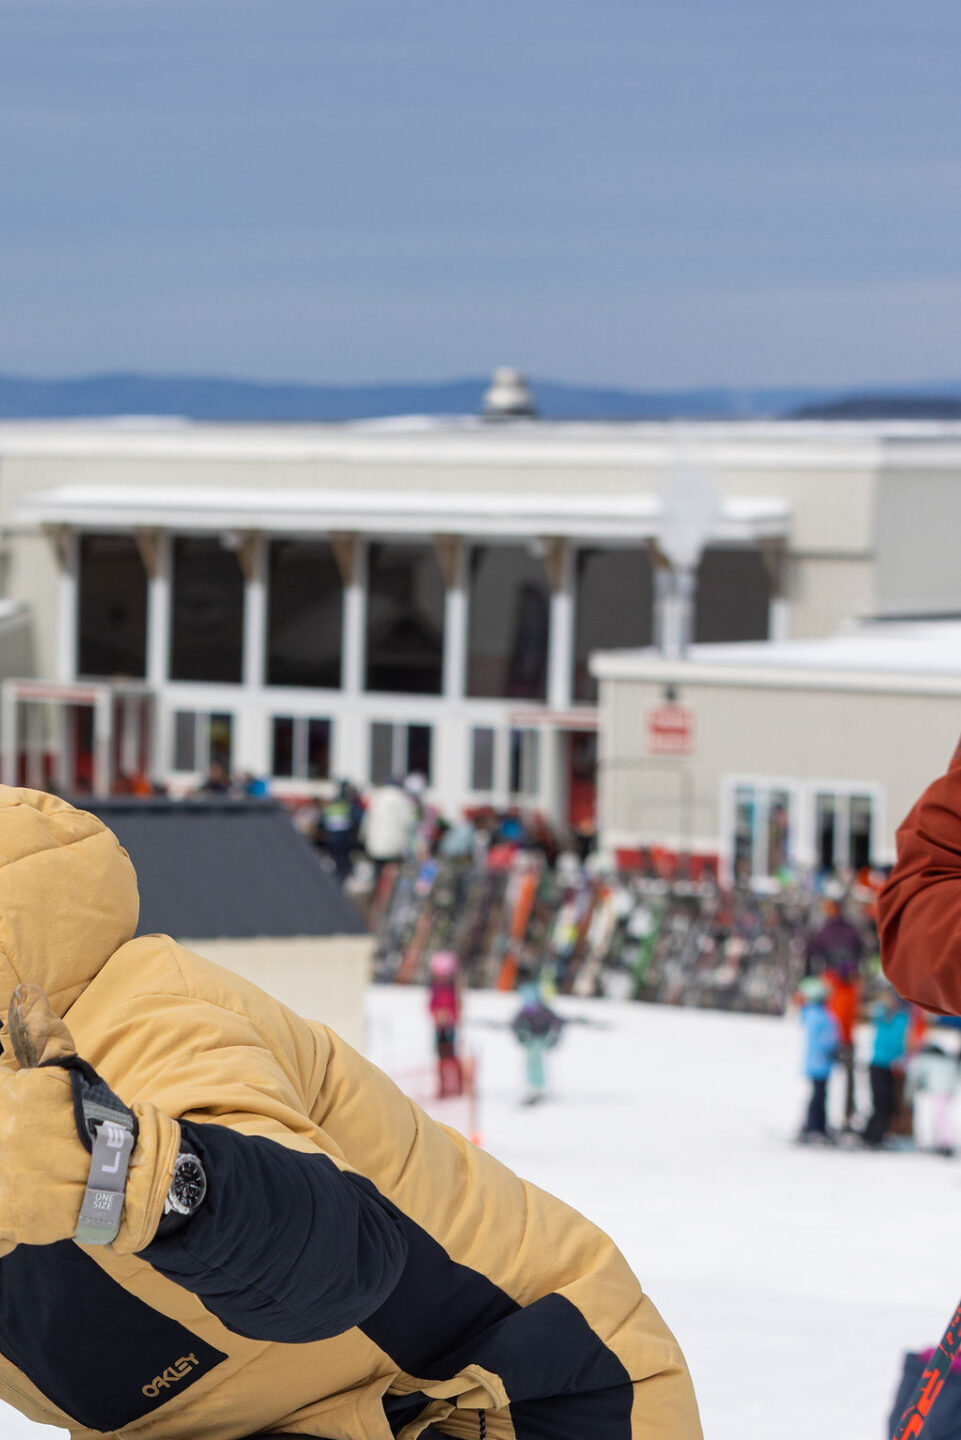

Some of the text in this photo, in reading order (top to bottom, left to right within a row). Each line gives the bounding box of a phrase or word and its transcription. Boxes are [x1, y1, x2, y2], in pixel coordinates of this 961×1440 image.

[94, 1192, 115, 1202] ONE
[92, 1200, 114, 1210] SIZE
[141, 1352, 200, 1398] OAKLEY
